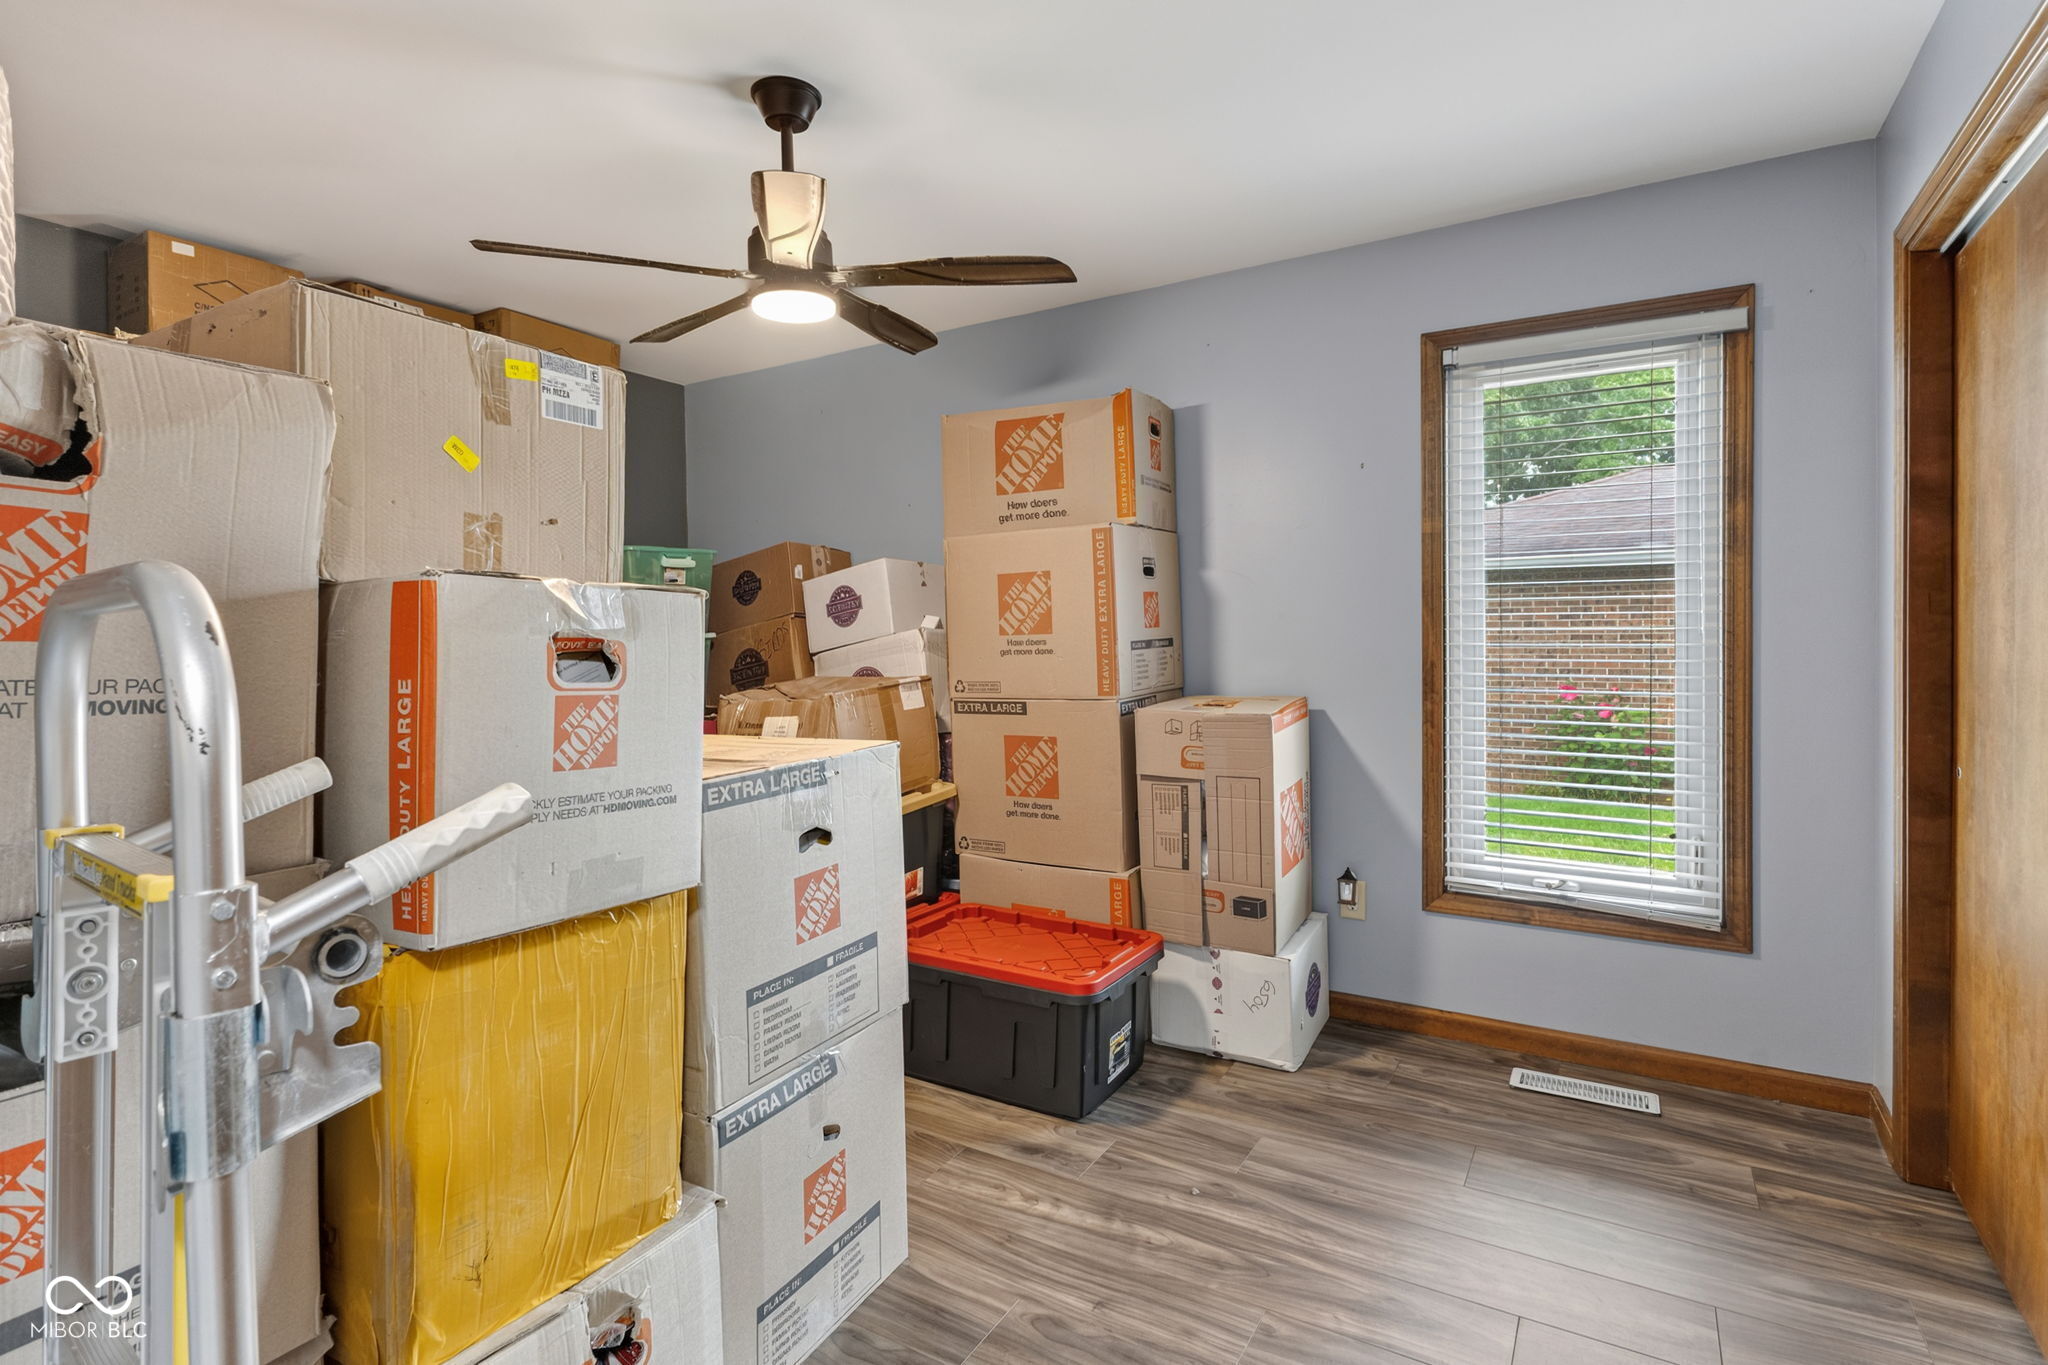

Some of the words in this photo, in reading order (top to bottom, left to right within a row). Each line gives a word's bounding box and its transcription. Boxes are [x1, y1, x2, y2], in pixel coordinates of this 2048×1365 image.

[995, 415, 1062, 494] HOME
[1001, 424, 1029, 456] THE
[1117, 425, 1126, 459] LARGE
[1021, 439, 1063, 492] DEPOT
[998, 512, 1013, 525] get
[1015, 511, 1040, 521] more
[1007, 500, 1028, 511] How
[1030, 498, 1058, 509] doers
[1096, 532, 1106, 575] LARGE
[999, 571, 1051, 635] HOME
[1003, 578, 1025, 604] THE
[1098, 580, 1108, 622] EXTRA
[1020, 593, 1051, 634] DEPOT
[1000, 648, 1012, 657] get
[1013, 648, 1033, 656] more
[1007, 639, 1024, 647] How
[1025, 638, 1047, 647] doers
[1101, 627, 1109, 655] DUTY
[397, 679, 412, 769] LARGE
[561, 702, 590, 733] THE
[958, 703, 988, 713] EXTRA
[990, 703, 1023, 713] LARGE
[553, 695, 618, 771] HOME
[579, 720, 618, 769] DEPOT
[1006, 736, 1057, 797] HOME
[1010, 742, 1033, 766] THE
[707, 778, 765, 806] EXTRA
[771, 765, 822, 792] LARGE
[1026, 759, 1058, 797] DEPOT
[552, 805, 588, 821] NEEDS
[588, 804, 601, 816] AT
[602, 794, 678, 814] HDMOVING.COM
[558, 791, 605, 808] ESTIMATE
[608, 788, 635, 801] YOUR
[635, 783, 673, 797] PACKING
[1013, 800, 1030, 810] How
[1031, 801, 1053, 811] doers
[1006, 809, 1018, 818] get
[1020, 811, 1039, 819] more
[796, 866, 839, 942] HOME
[800, 877, 819, 908] THE
[1113, 881, 1123, 926] LARGE
[814, 887, 841, 936] DEPOT
[835, 942, 864, 963] FRAGILE
[753, 980, 782, 1001] PLACE
[783, 976, 795, 989] IN:
[725, 1092, 781, 1139] EXTRA
[784, 1058, 832, 1102] LARGE
[805, 1154, 846, 1238] HOME
[823, 1171, 846, 1227] DEPOT
[840, 1217, 867, 1248] FRAGILE
[763, 1286, 790, 1316] PLACE
